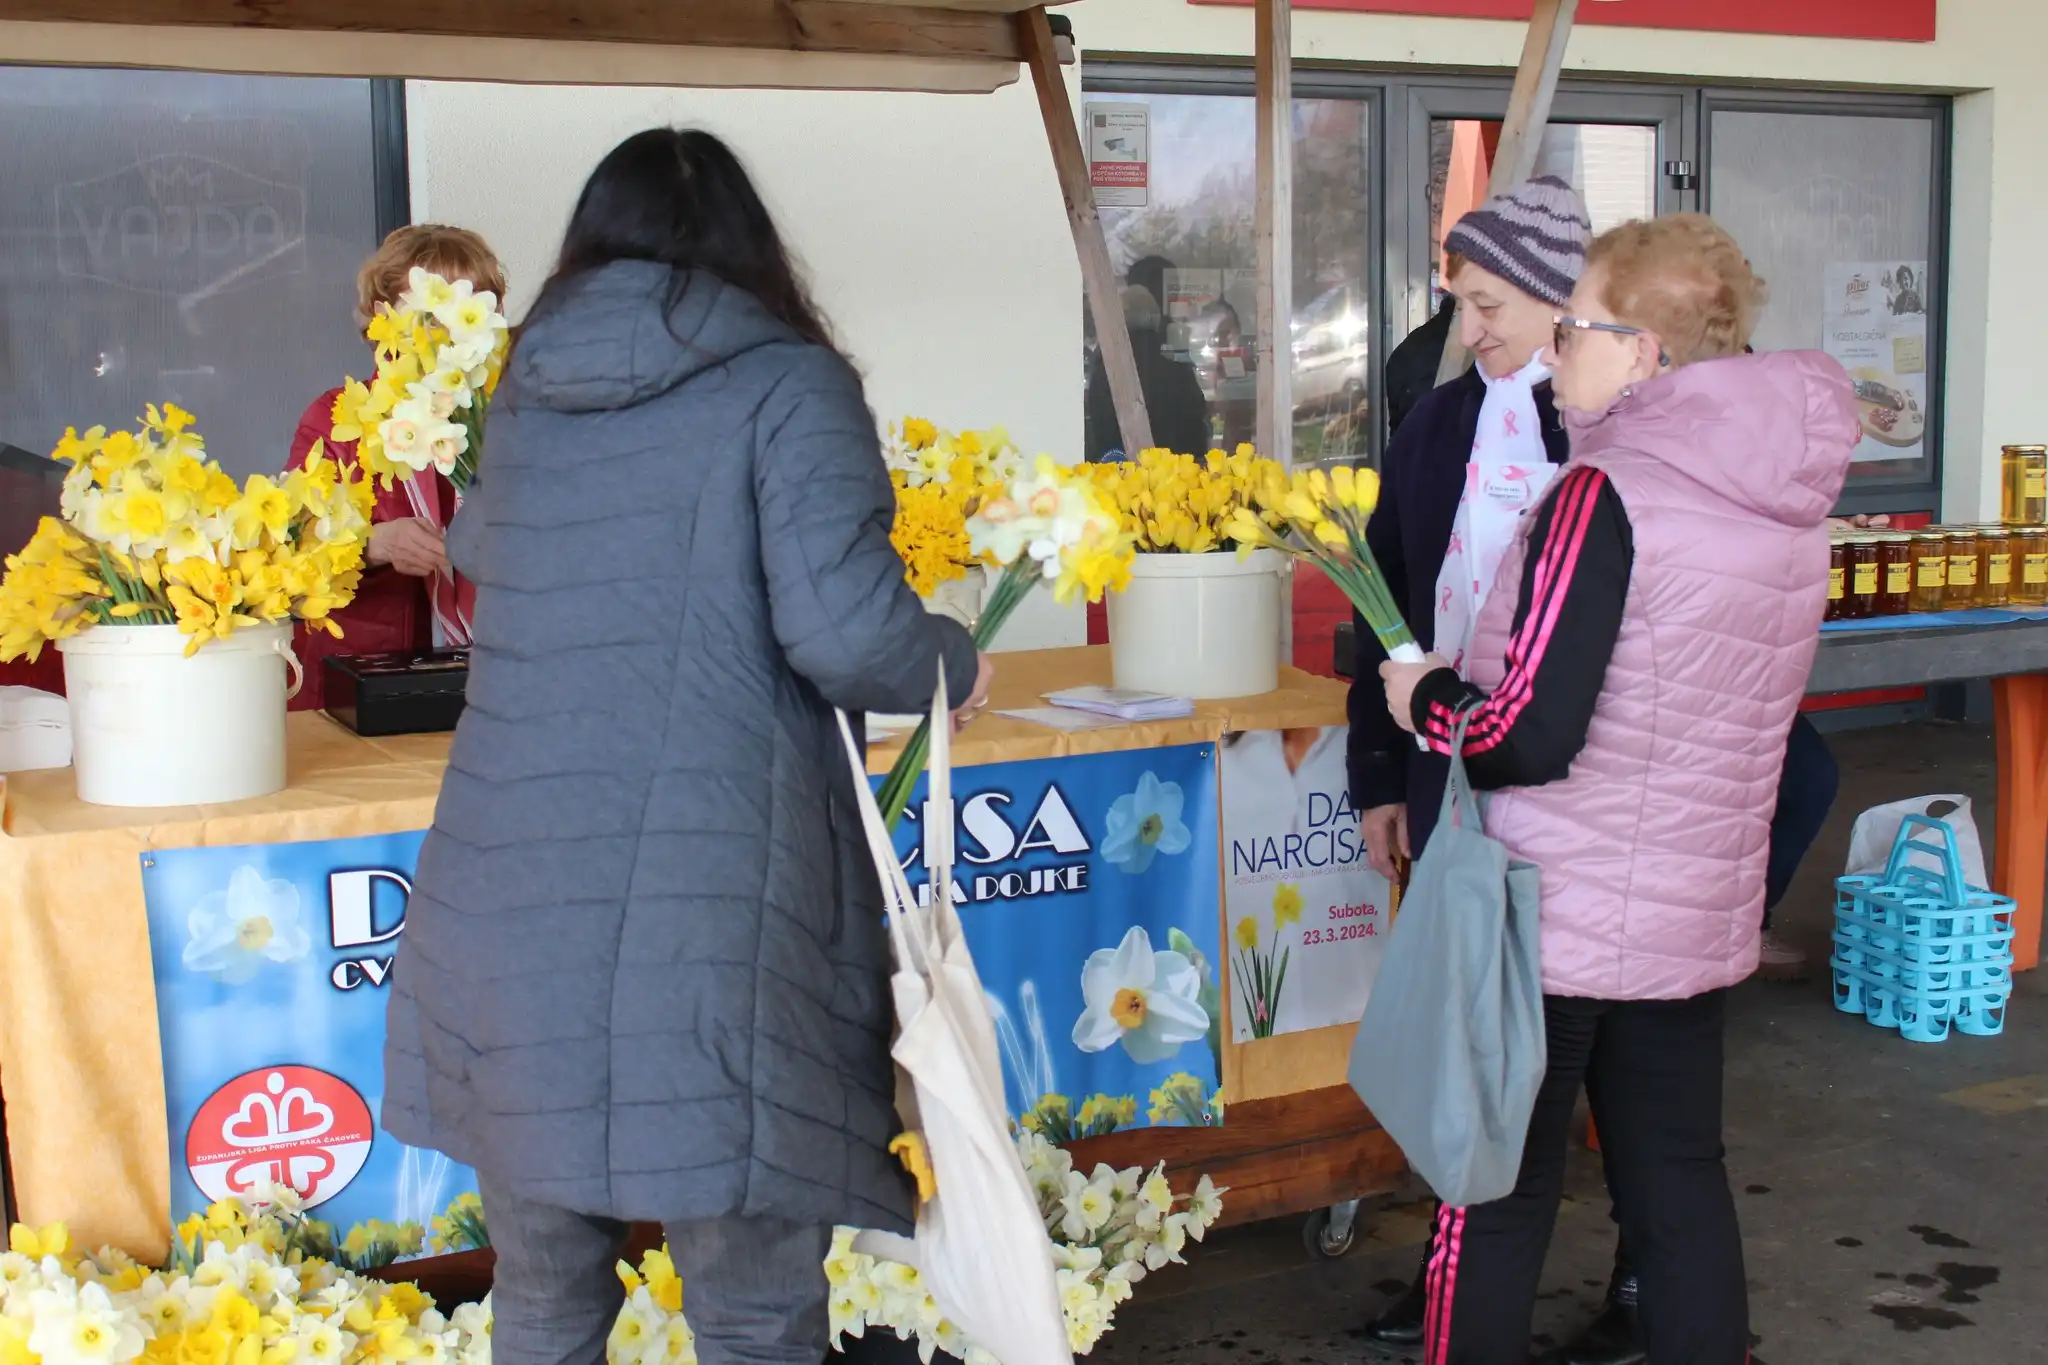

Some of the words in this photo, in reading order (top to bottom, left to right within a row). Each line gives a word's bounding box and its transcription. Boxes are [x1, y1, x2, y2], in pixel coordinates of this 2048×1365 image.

[74, 203, 284, 258] VAJDA
[1308, 790, 1363, 827] DA
[975, 865, 1087, 900] DOJKE
[1329, 903, 1378, 920] Subota,
[1303, 922, 1378, 946] 23.3.2024.
[196, 1149, 247, 1162] ŽUPANIJSKA
[248, 1146, 267, 1154] LIGA
[270, 1141, 298, 1151] PROTIV
[300, 1138, 322, 1146] RAKA
[323, 1133, 361, 1144] ČAKOVEC
